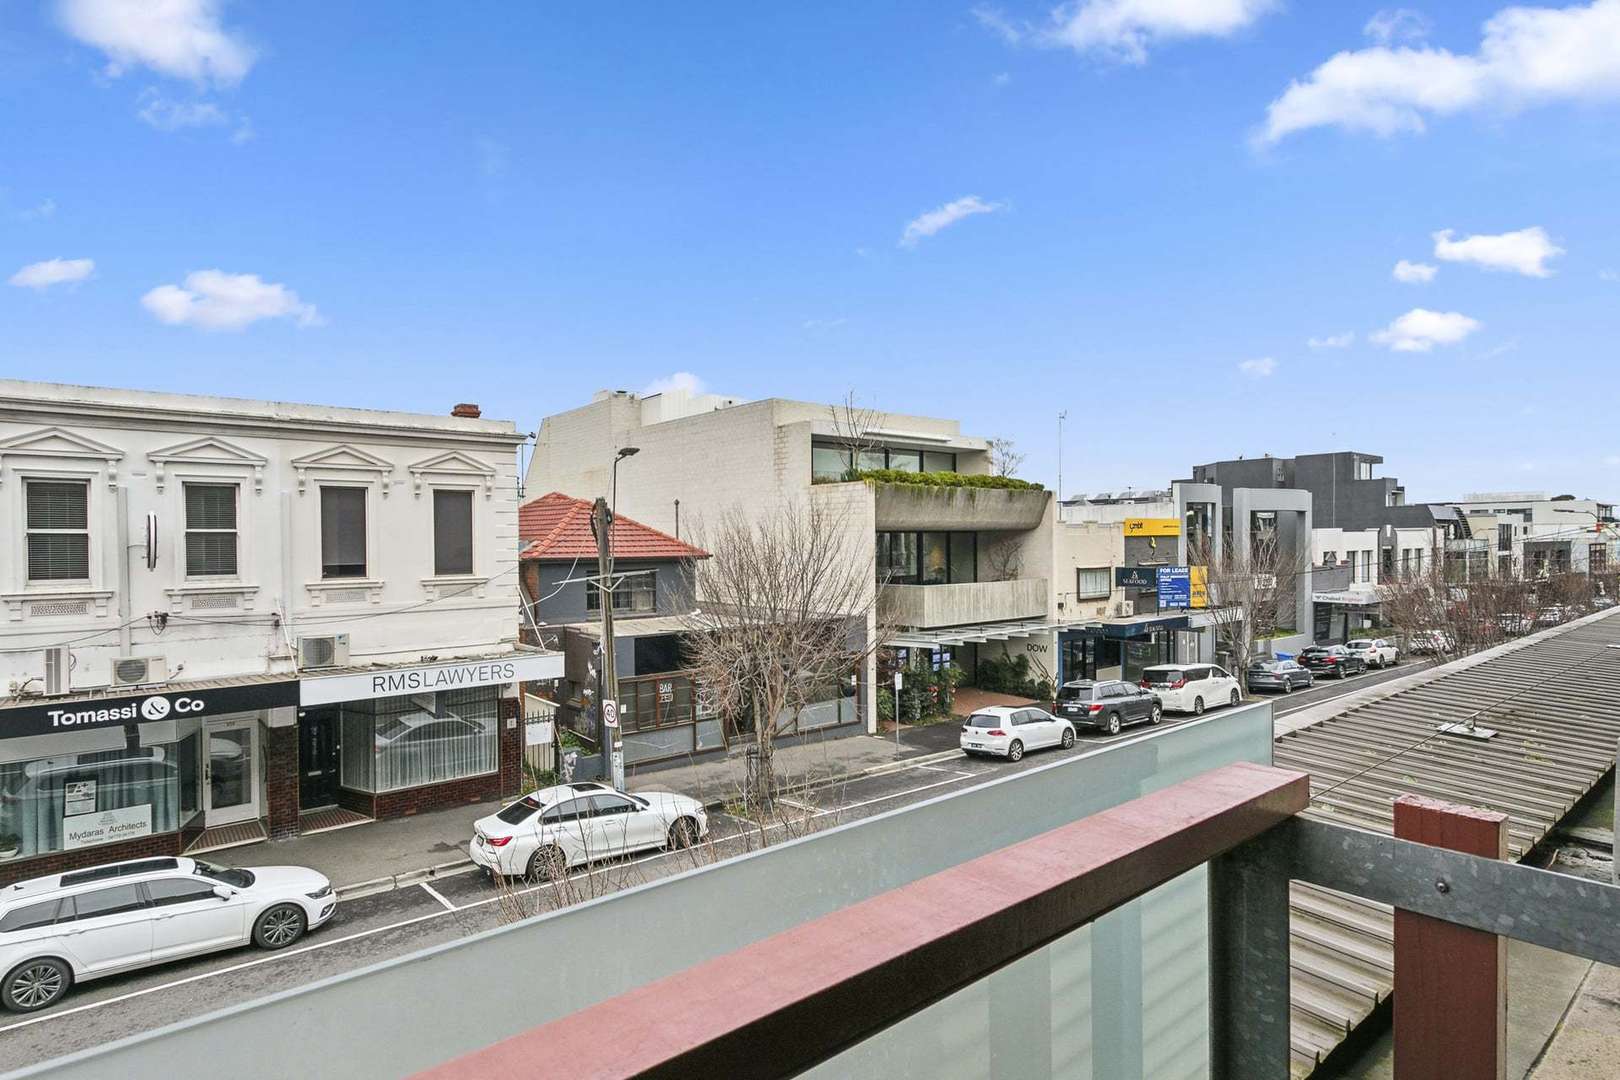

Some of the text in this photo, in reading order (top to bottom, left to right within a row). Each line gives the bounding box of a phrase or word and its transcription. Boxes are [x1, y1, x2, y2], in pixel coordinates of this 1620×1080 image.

[1027, 643, 1048, 653] DOW
[659, 683, 673, 693] BAR
[47, 697, 205, 727] Tomassi & Co
[606, 706, 615, 718] 40
[69, 828, 105, 842] Mydaras
[108, 820, 147, 834] Architects
